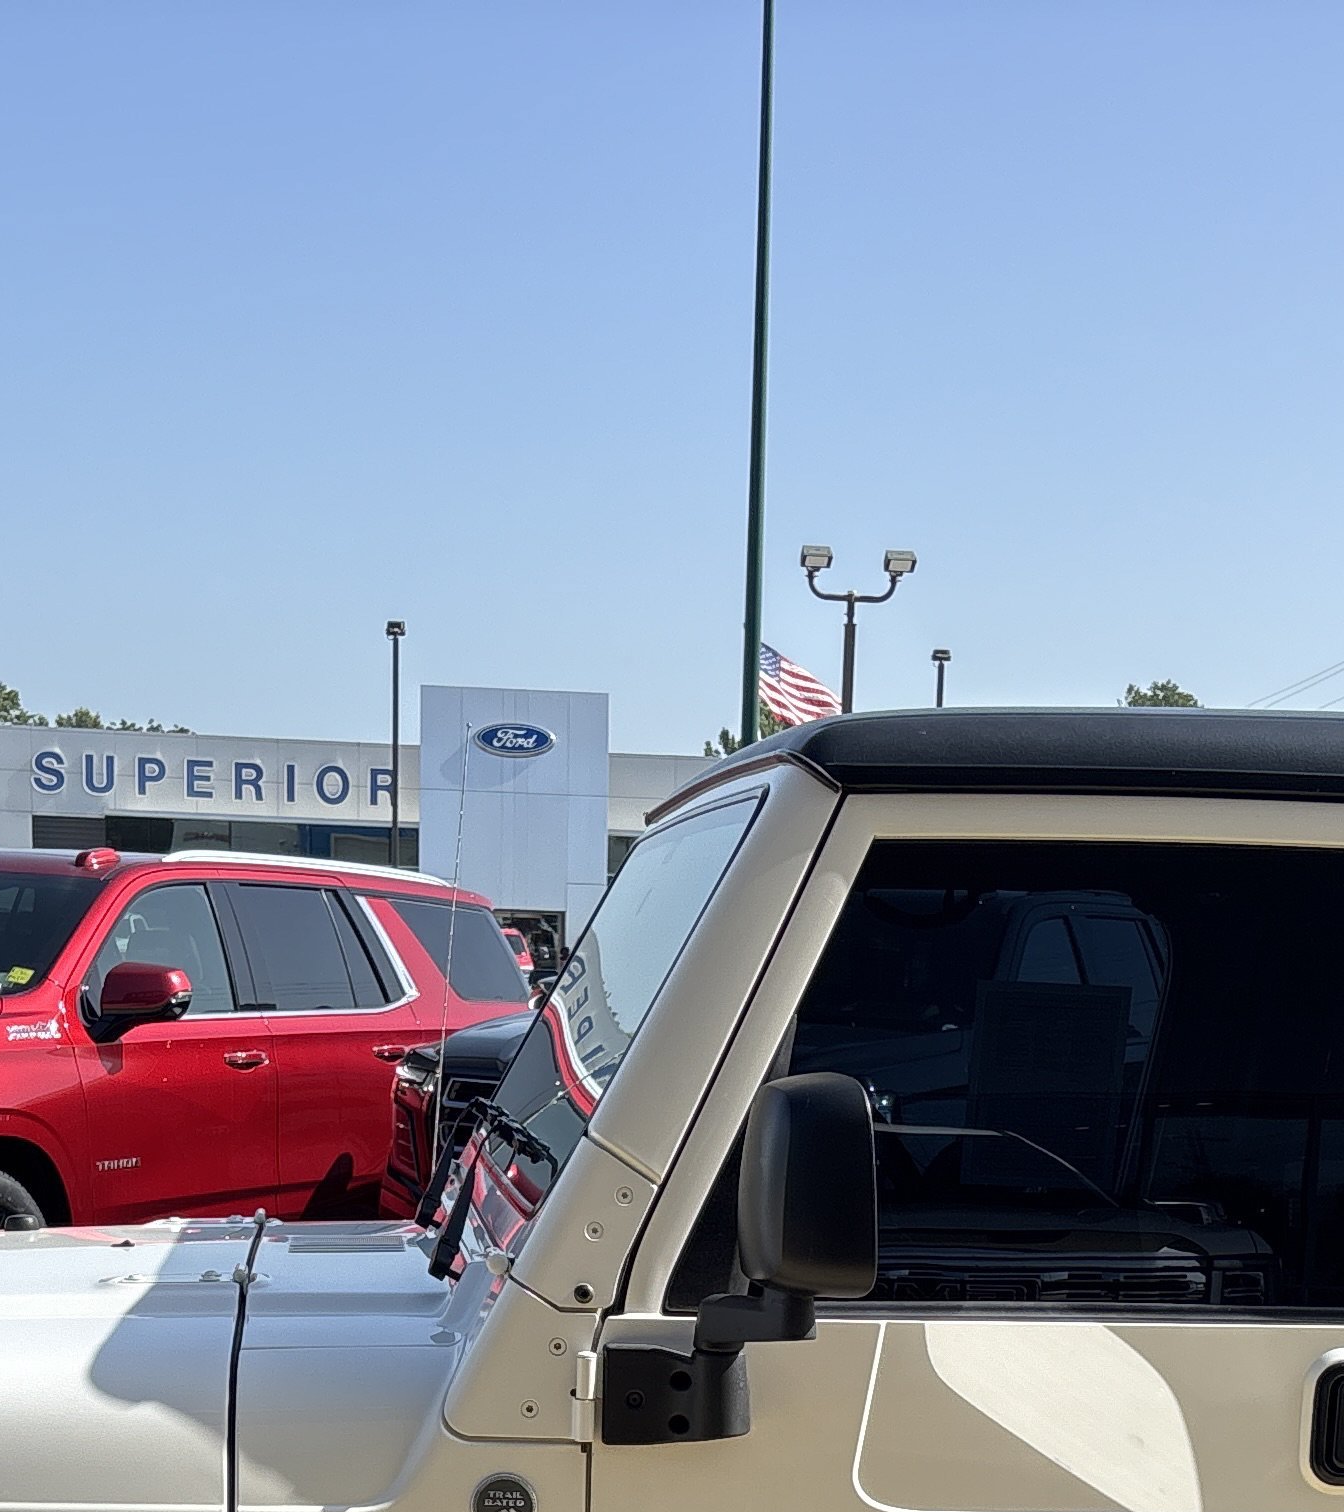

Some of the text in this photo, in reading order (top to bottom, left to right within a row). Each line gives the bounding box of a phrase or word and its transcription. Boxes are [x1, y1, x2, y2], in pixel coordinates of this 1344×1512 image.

[493, 729, 538, 748] Ford
[32, 750, 396, 807] SUPERIOR
[487, 1490, 524, 1499] TRAIL
[483, 1498, 525, 1507] RATED
